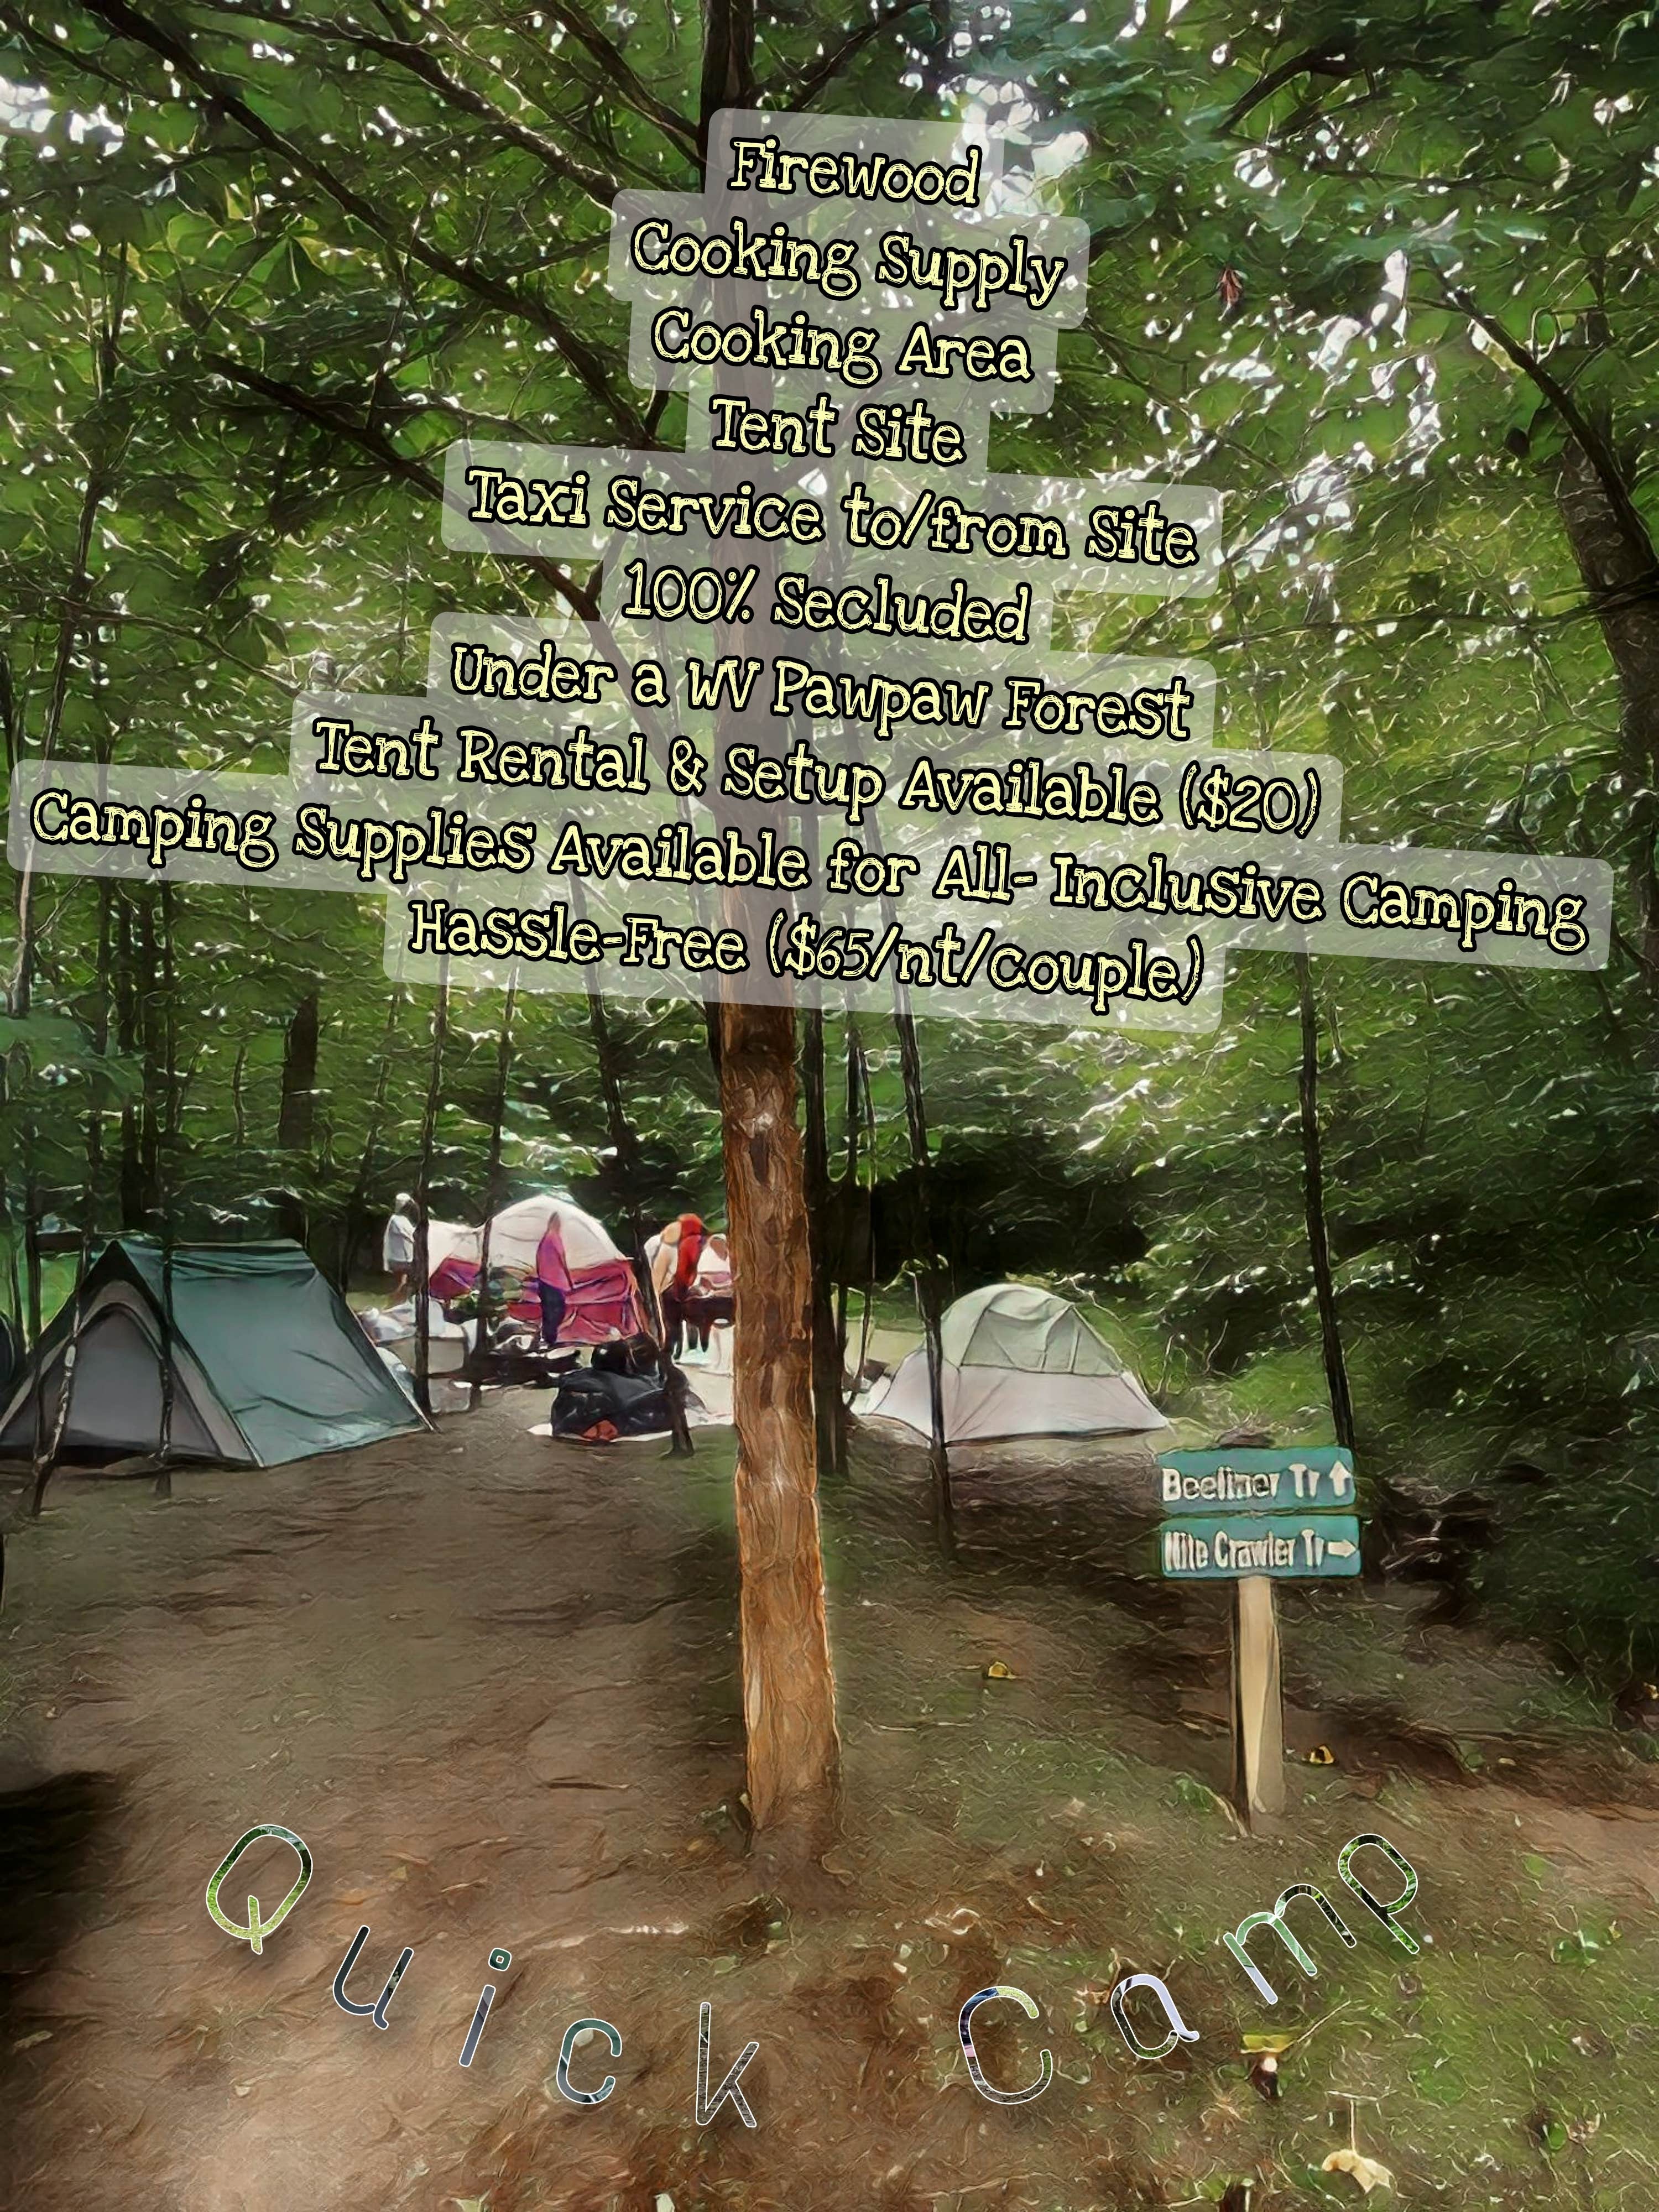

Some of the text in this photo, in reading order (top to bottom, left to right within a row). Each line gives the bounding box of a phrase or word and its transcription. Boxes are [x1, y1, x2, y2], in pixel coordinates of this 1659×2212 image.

[1162, 1463, 1319, 1502] Beeliner Tr
[1214, 1530, 1296, 1569] Crawler
[1301, 1528, 1324, 1567] Tr
